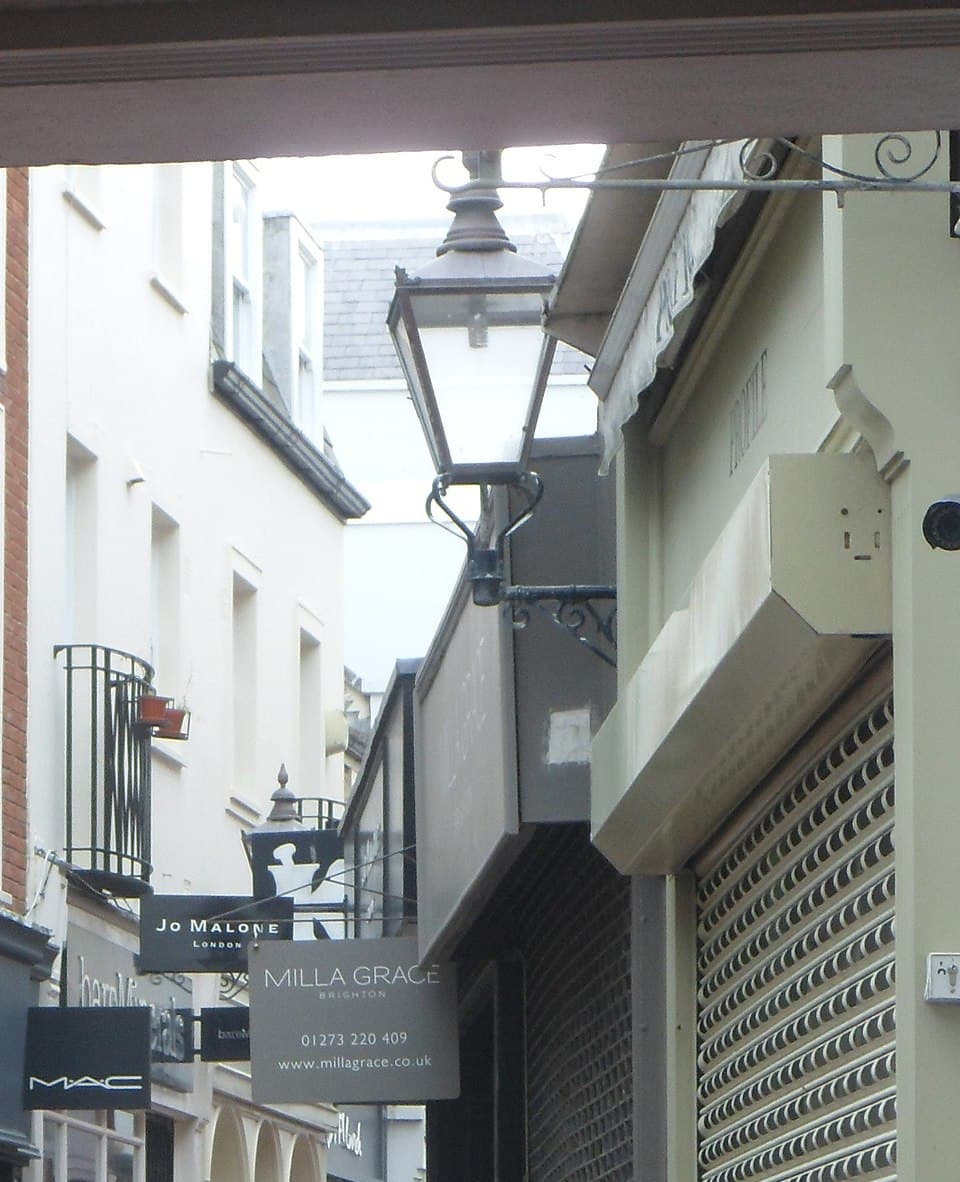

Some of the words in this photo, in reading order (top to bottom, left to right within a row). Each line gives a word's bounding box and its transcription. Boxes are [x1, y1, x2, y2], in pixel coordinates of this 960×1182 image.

[155, 918, 181, 932] Jo
[190, 919, 279, 934] MALONE
[192, 940, 242, 949] LONDON
[264, 967, 346, 989] MILLA
[353, 964, 441, 986] GRACE
[318, 990, 387, 1000] BRIGHTON
[301, 1033, 344, 1048] 01273
[351, 1032, 377, 1046] 220
[382, 1031, 408, 1045] 409
[278, 1054, 432, 1072] www.millagrace.co.uk
